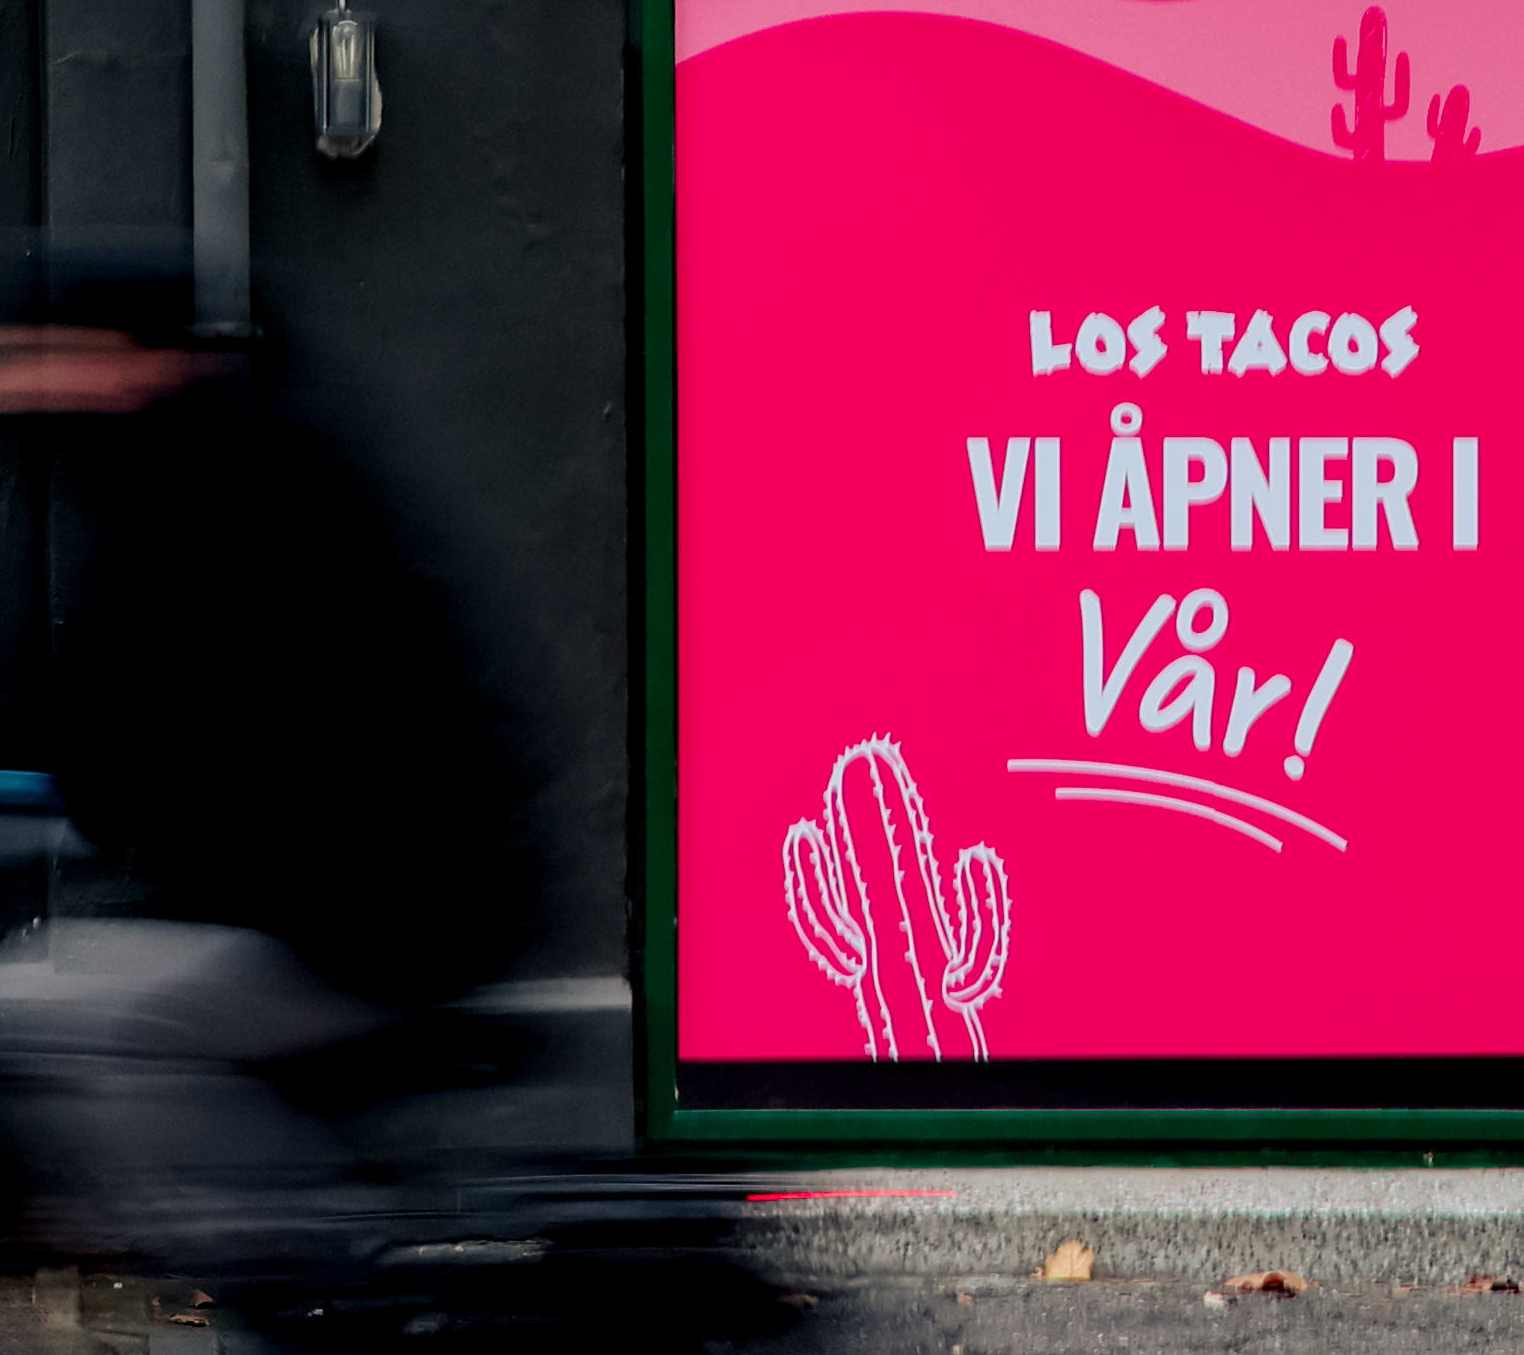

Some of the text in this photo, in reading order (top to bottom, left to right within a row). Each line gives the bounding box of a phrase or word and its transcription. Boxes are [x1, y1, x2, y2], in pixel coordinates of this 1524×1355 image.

[1029, 305, 1420, 378] LOS TACOS
[966, 402, 1479, 550] VI ÅPNER I
[1079, 588, 1354, 780] Vår!
